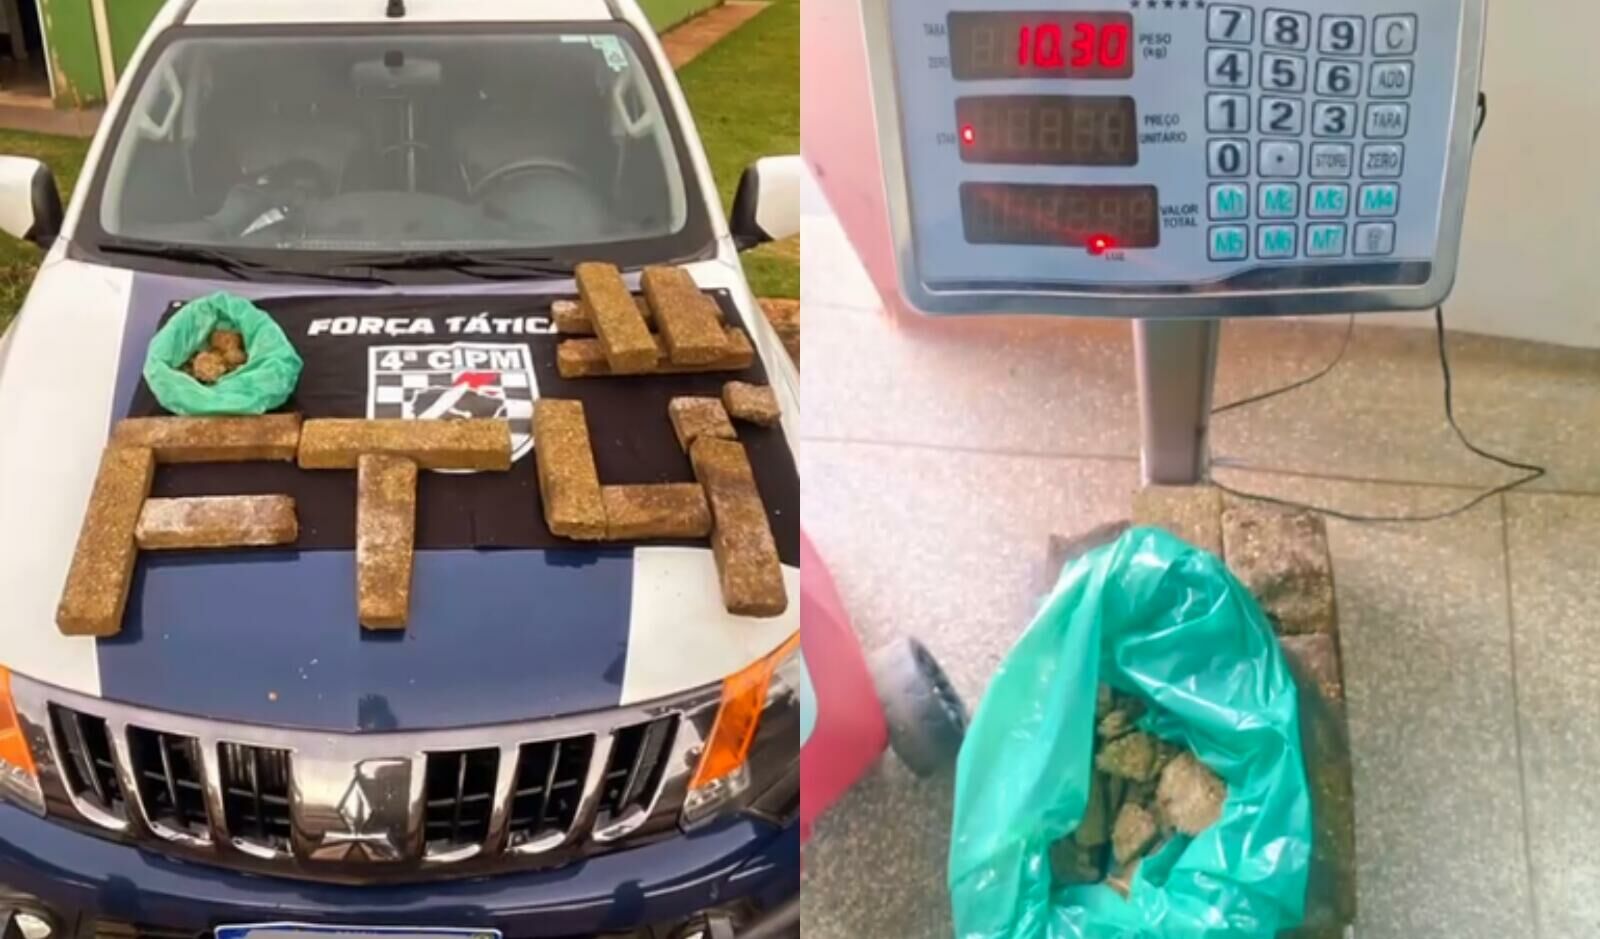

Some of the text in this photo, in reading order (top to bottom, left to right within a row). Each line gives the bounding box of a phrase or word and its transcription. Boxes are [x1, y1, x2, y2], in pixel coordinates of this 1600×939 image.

[1139, 33, 1172, 45] PESO
[1219, 9, 1404, 51] 7 8 9 C
[1018, 23, 1128, 68] 10.30
[1143, 46, 1167, 60] (kg)
[1216, 53, 1406, 93] 4 5 6 ADD
[1144, 113, 1180, 127] PREÇO
[1219, 98, 1402, 134] 1 2 3 TARA
[1218, 143, 1241, 173] 0
[1366, 152, 1399, 170] ZERO
[1160, 204, 1199, 216] VALOR
[1216, 187, 1394, 214] M1 M2 M3 M4
[1164, 216, 1198, 228] TOTAL
[1215, 227, 1342, 253] M5 M6 M7
[307, 316, 435, 337] FORÇA
[427, 350, 521, 370] CIPM
